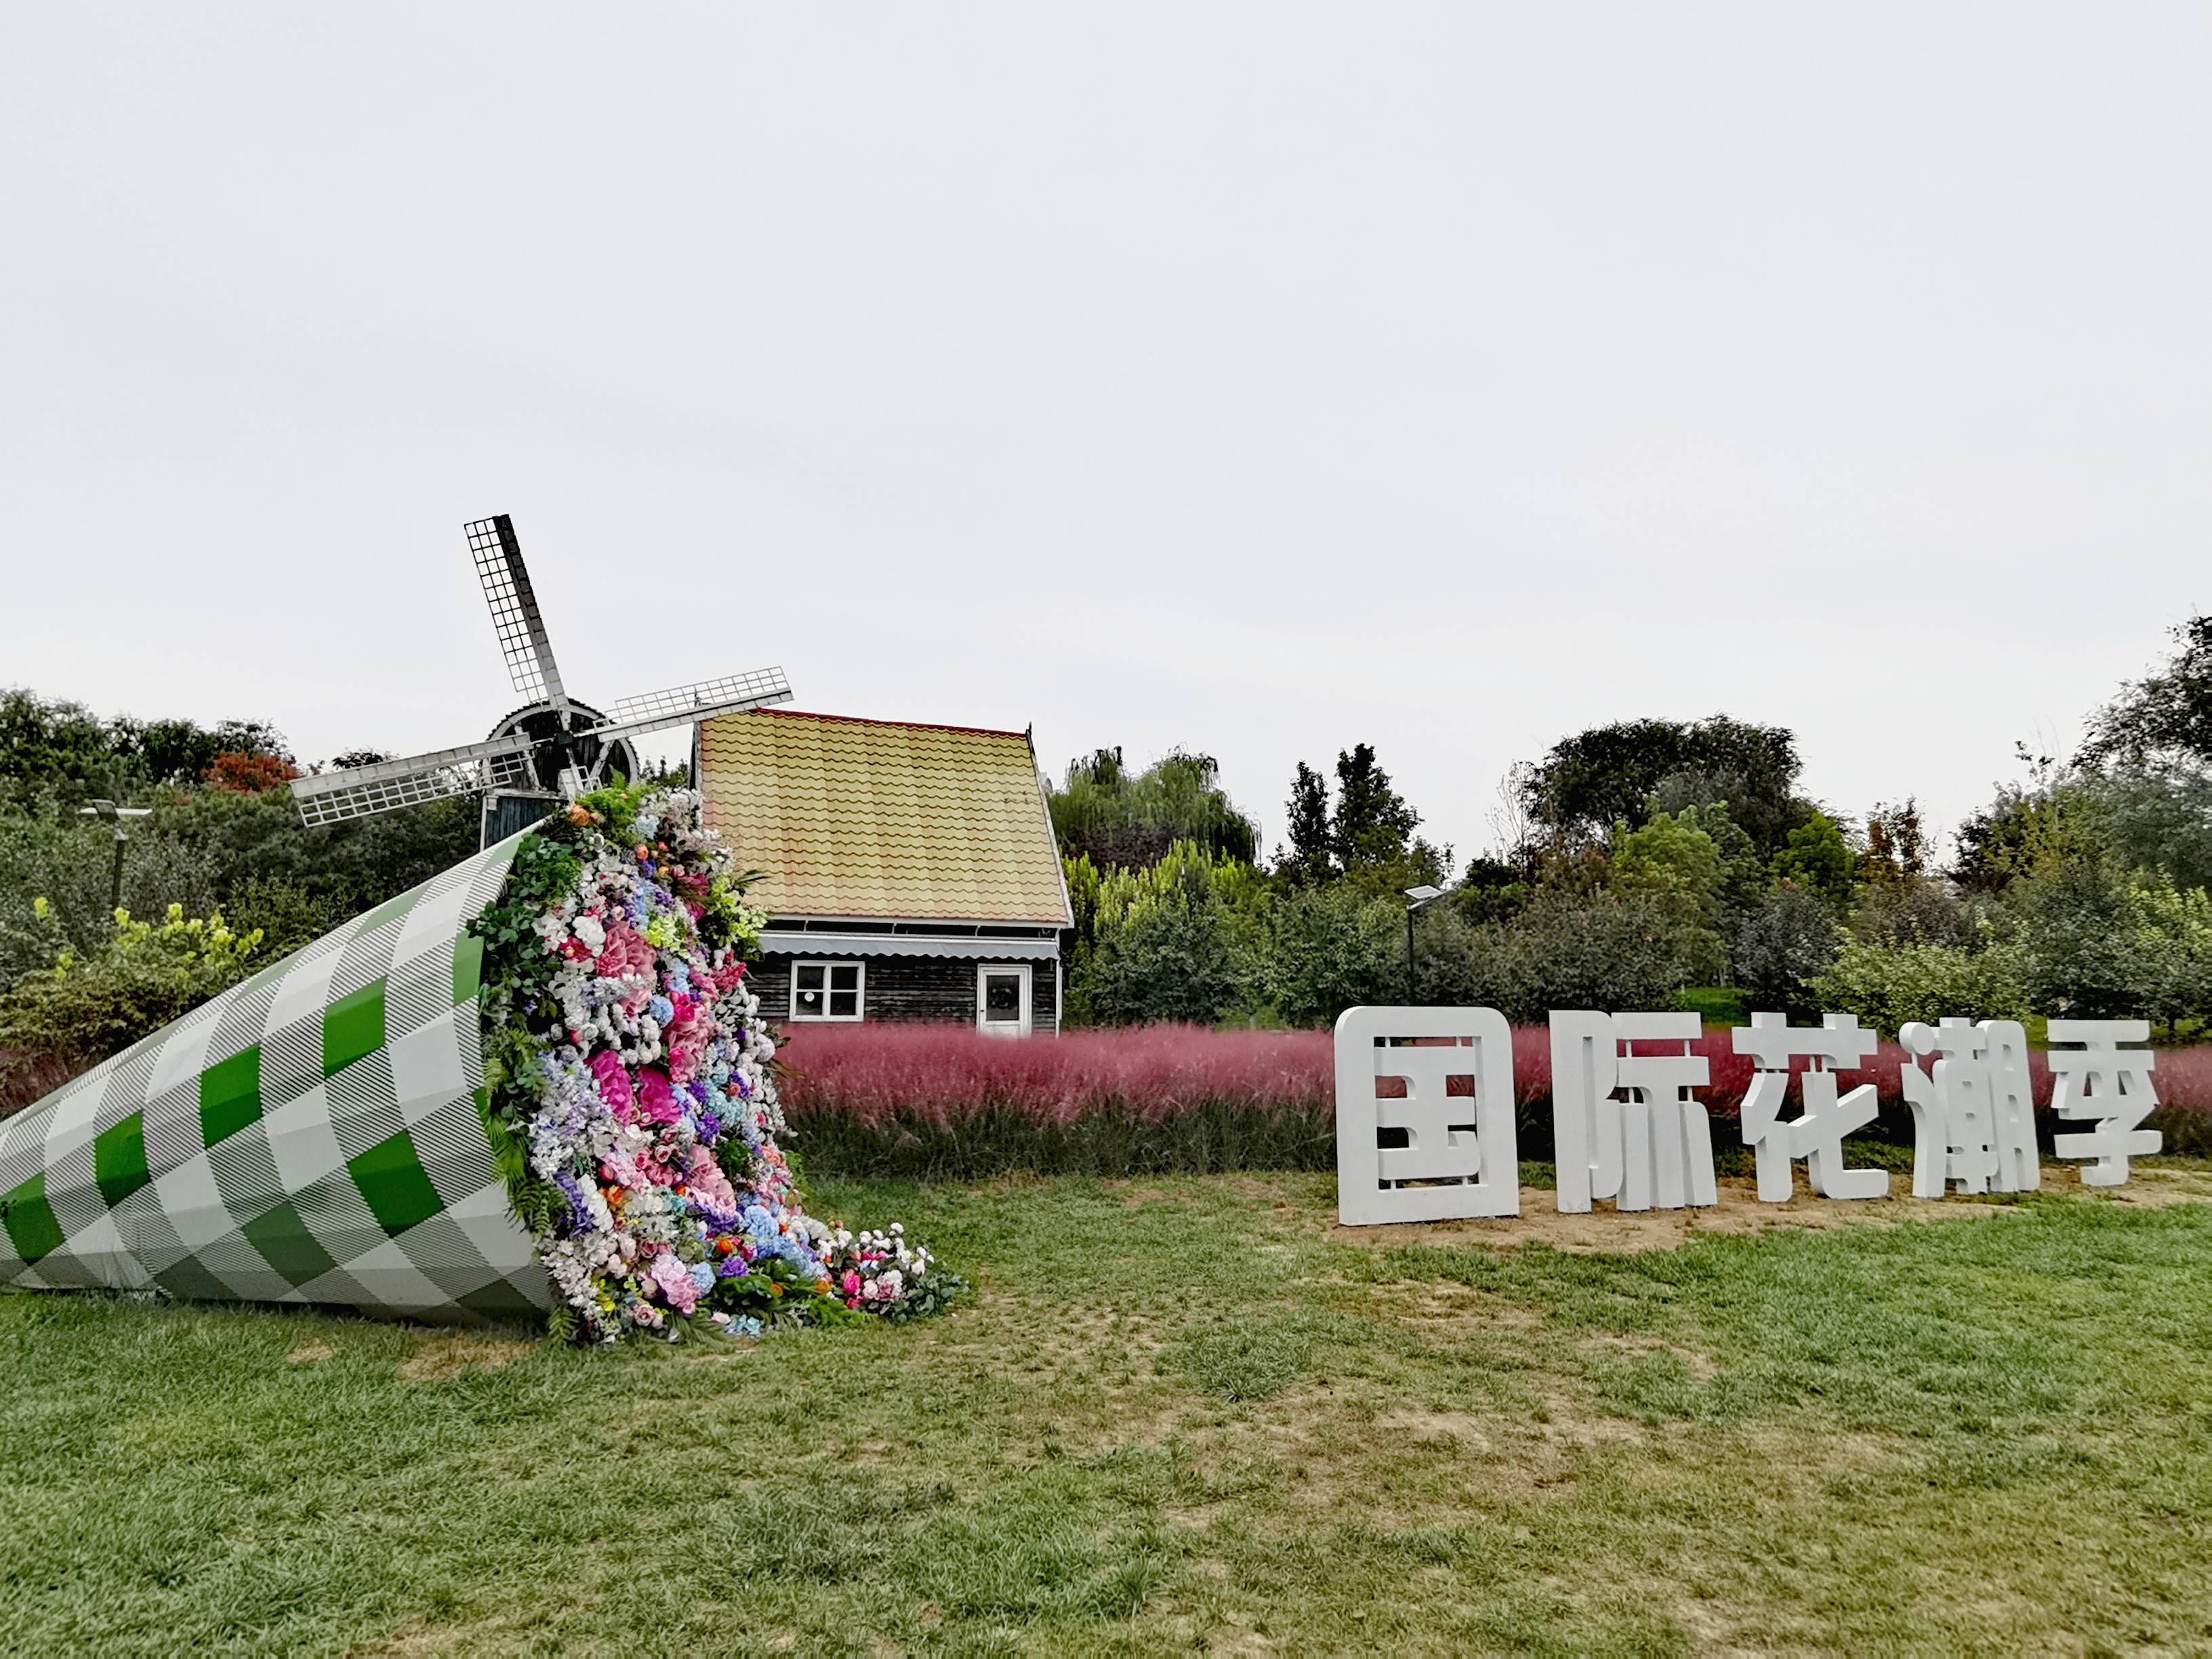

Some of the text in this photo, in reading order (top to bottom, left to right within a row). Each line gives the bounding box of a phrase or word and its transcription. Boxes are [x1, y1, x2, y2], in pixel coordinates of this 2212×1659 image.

[1334, 1006, 2163, 1226] 国际花潮季
